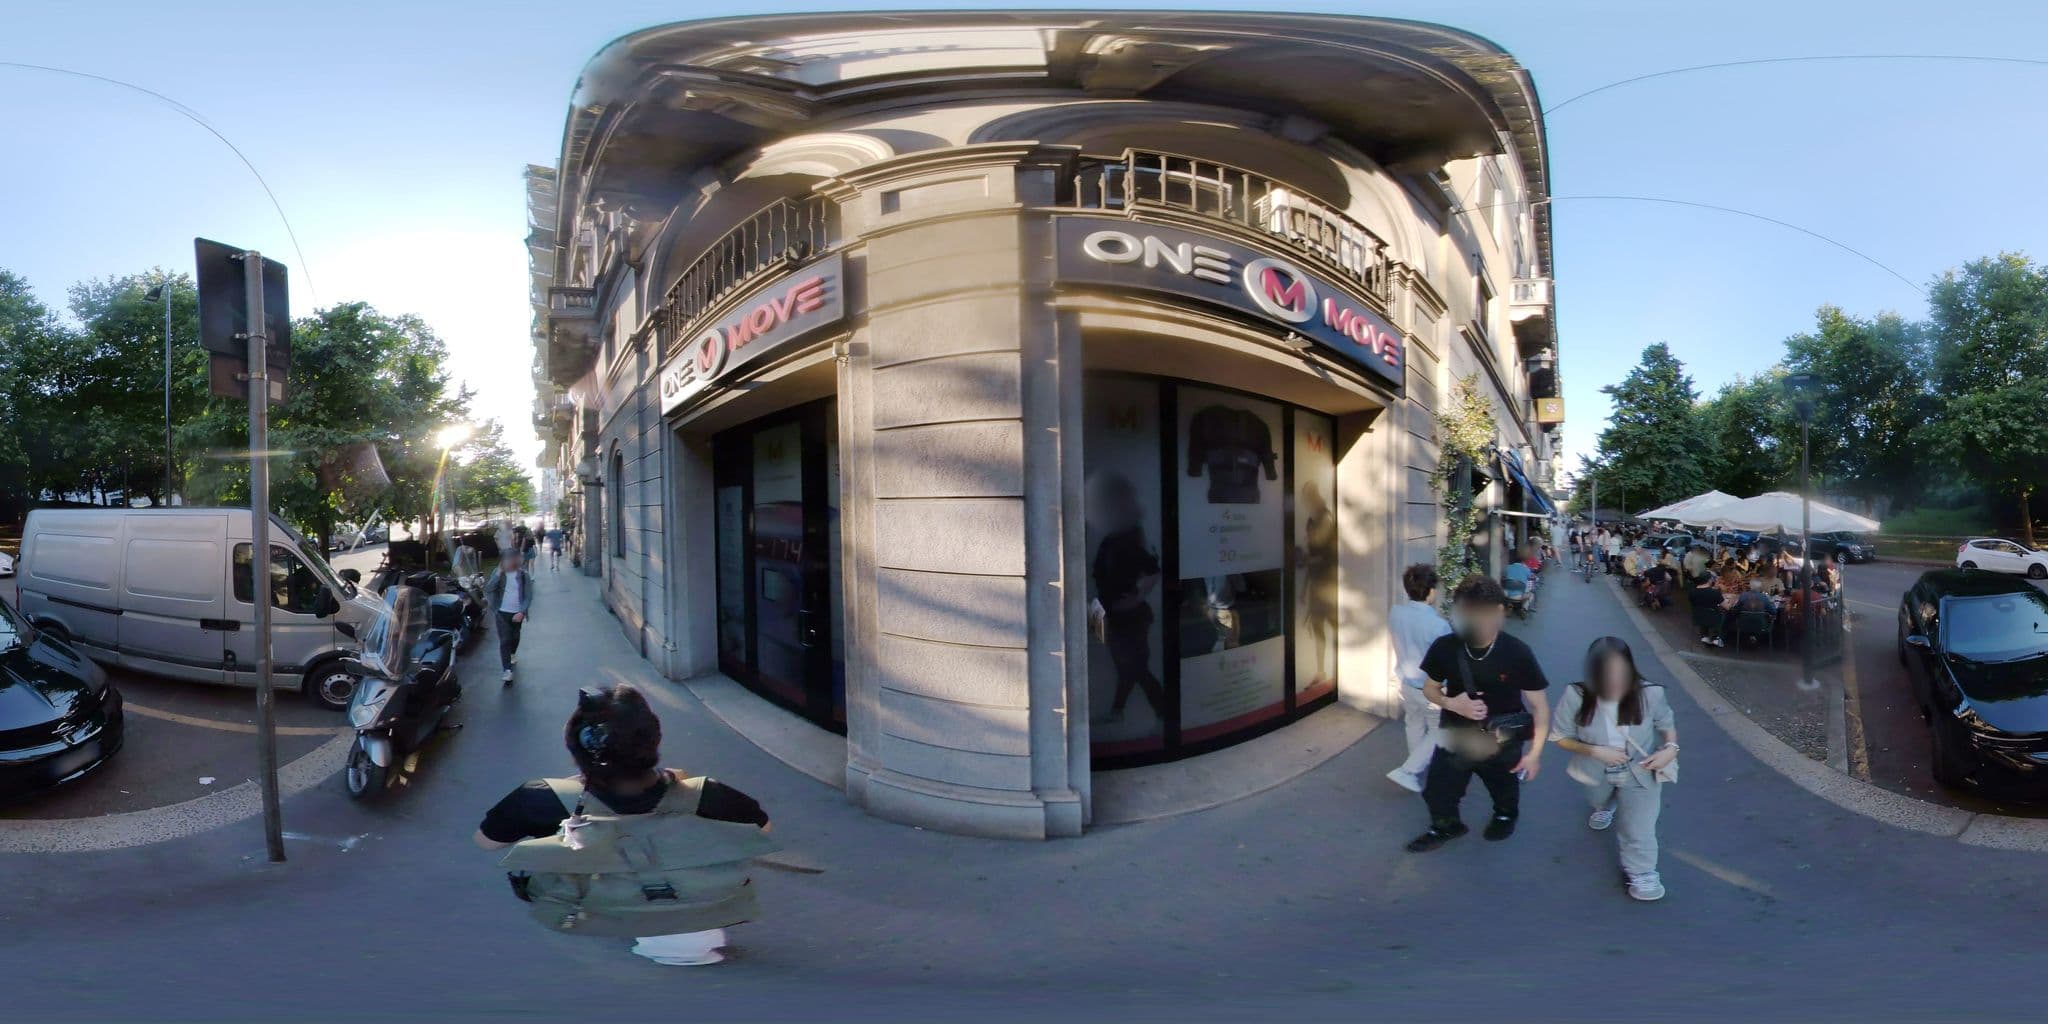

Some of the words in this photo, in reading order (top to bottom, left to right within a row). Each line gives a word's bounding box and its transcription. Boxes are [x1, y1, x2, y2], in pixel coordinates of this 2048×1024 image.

[663, 358, 695, 399] ONE
[727, 276, 824, 351] MOVE
[1083, 230, 1232, 285] ONE
[1323, 297, 1399, 366] MOVE
